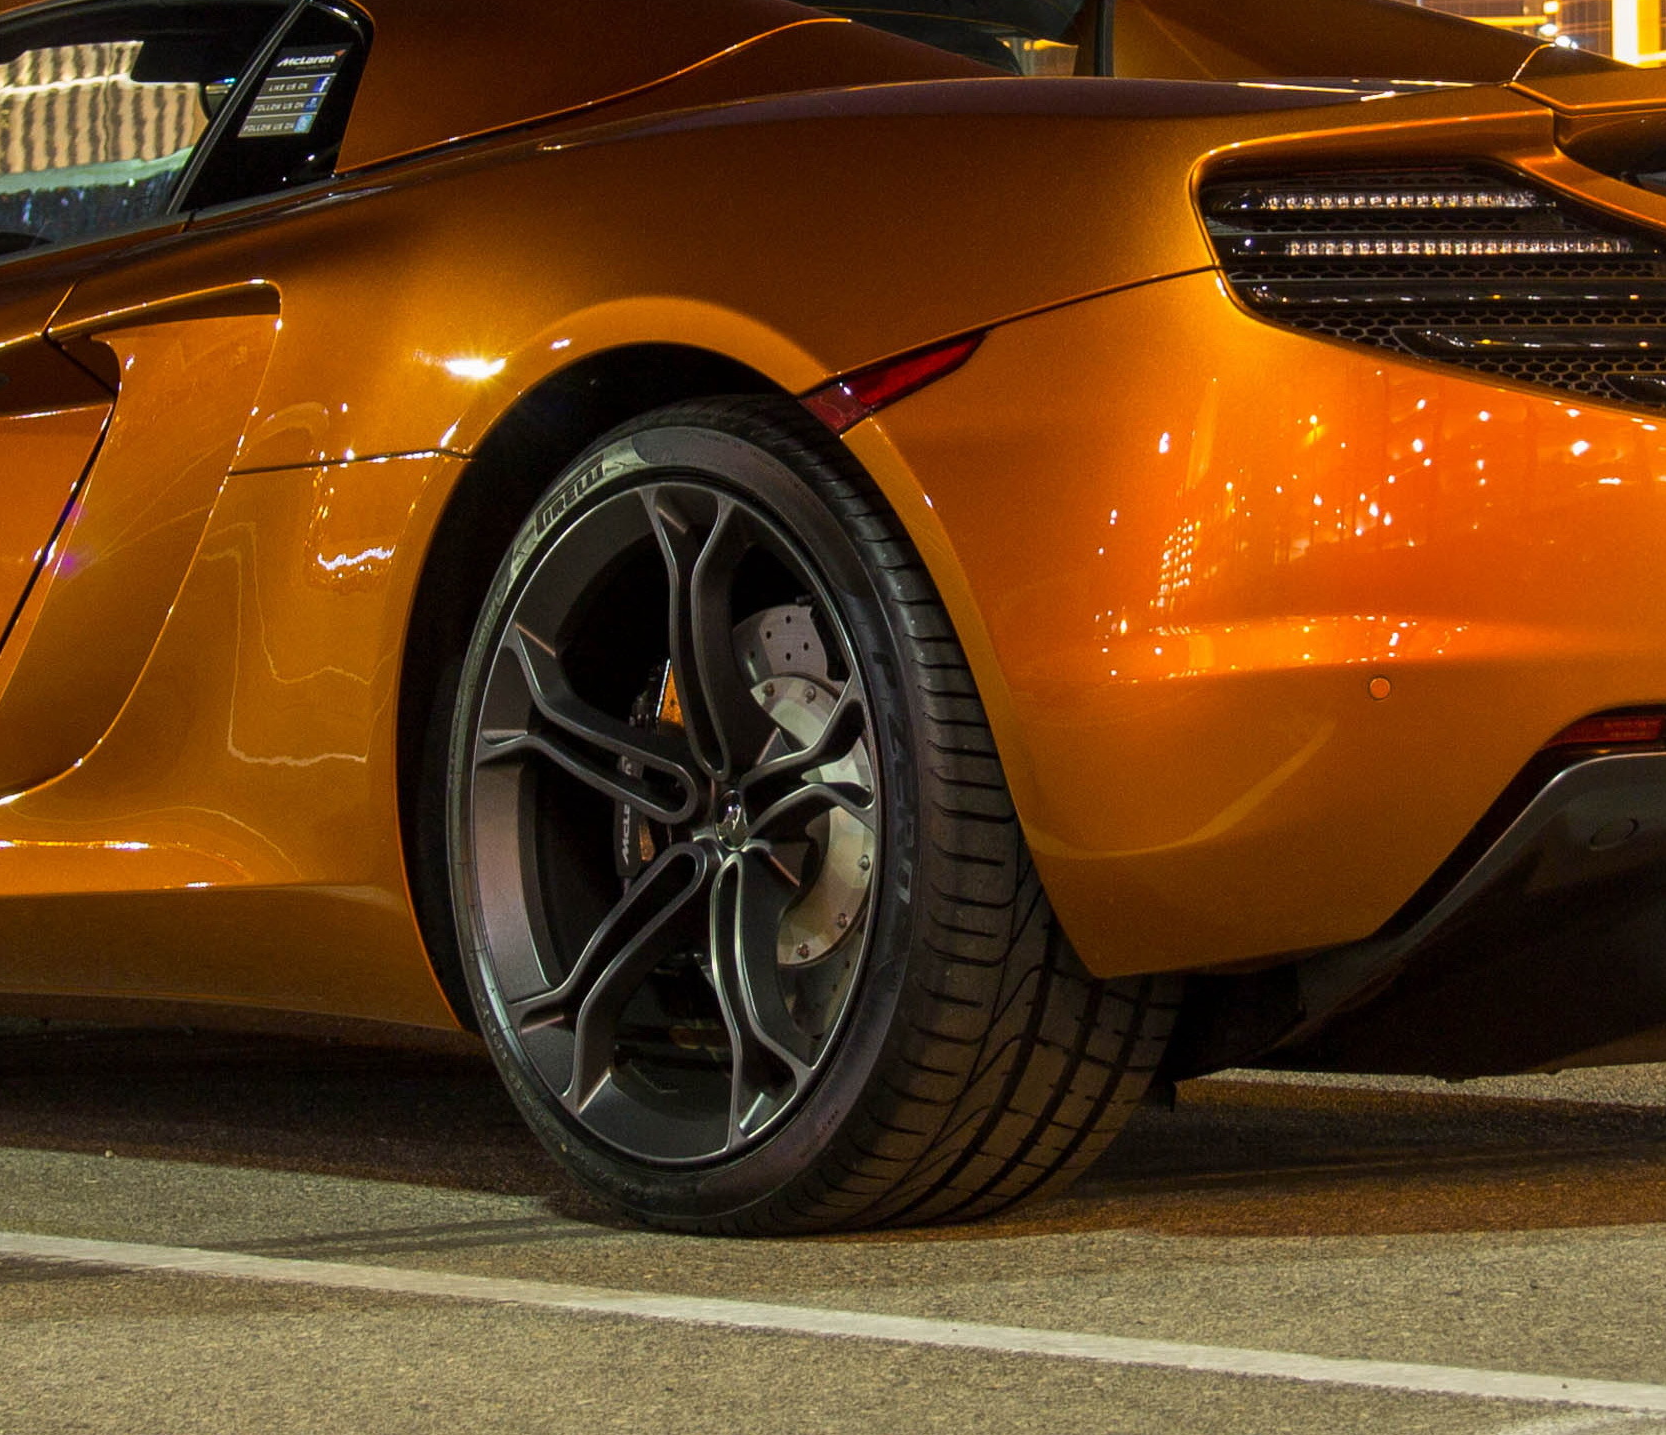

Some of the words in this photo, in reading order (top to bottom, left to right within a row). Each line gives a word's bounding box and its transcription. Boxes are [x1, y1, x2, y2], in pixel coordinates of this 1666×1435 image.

[276, 55, 336, 67] McLaren
[252, 103, 281, 112] FOLLOW
[243, 124, 272, 132] FOLLOW
[535, 453, 606, 537] PIRELLI
